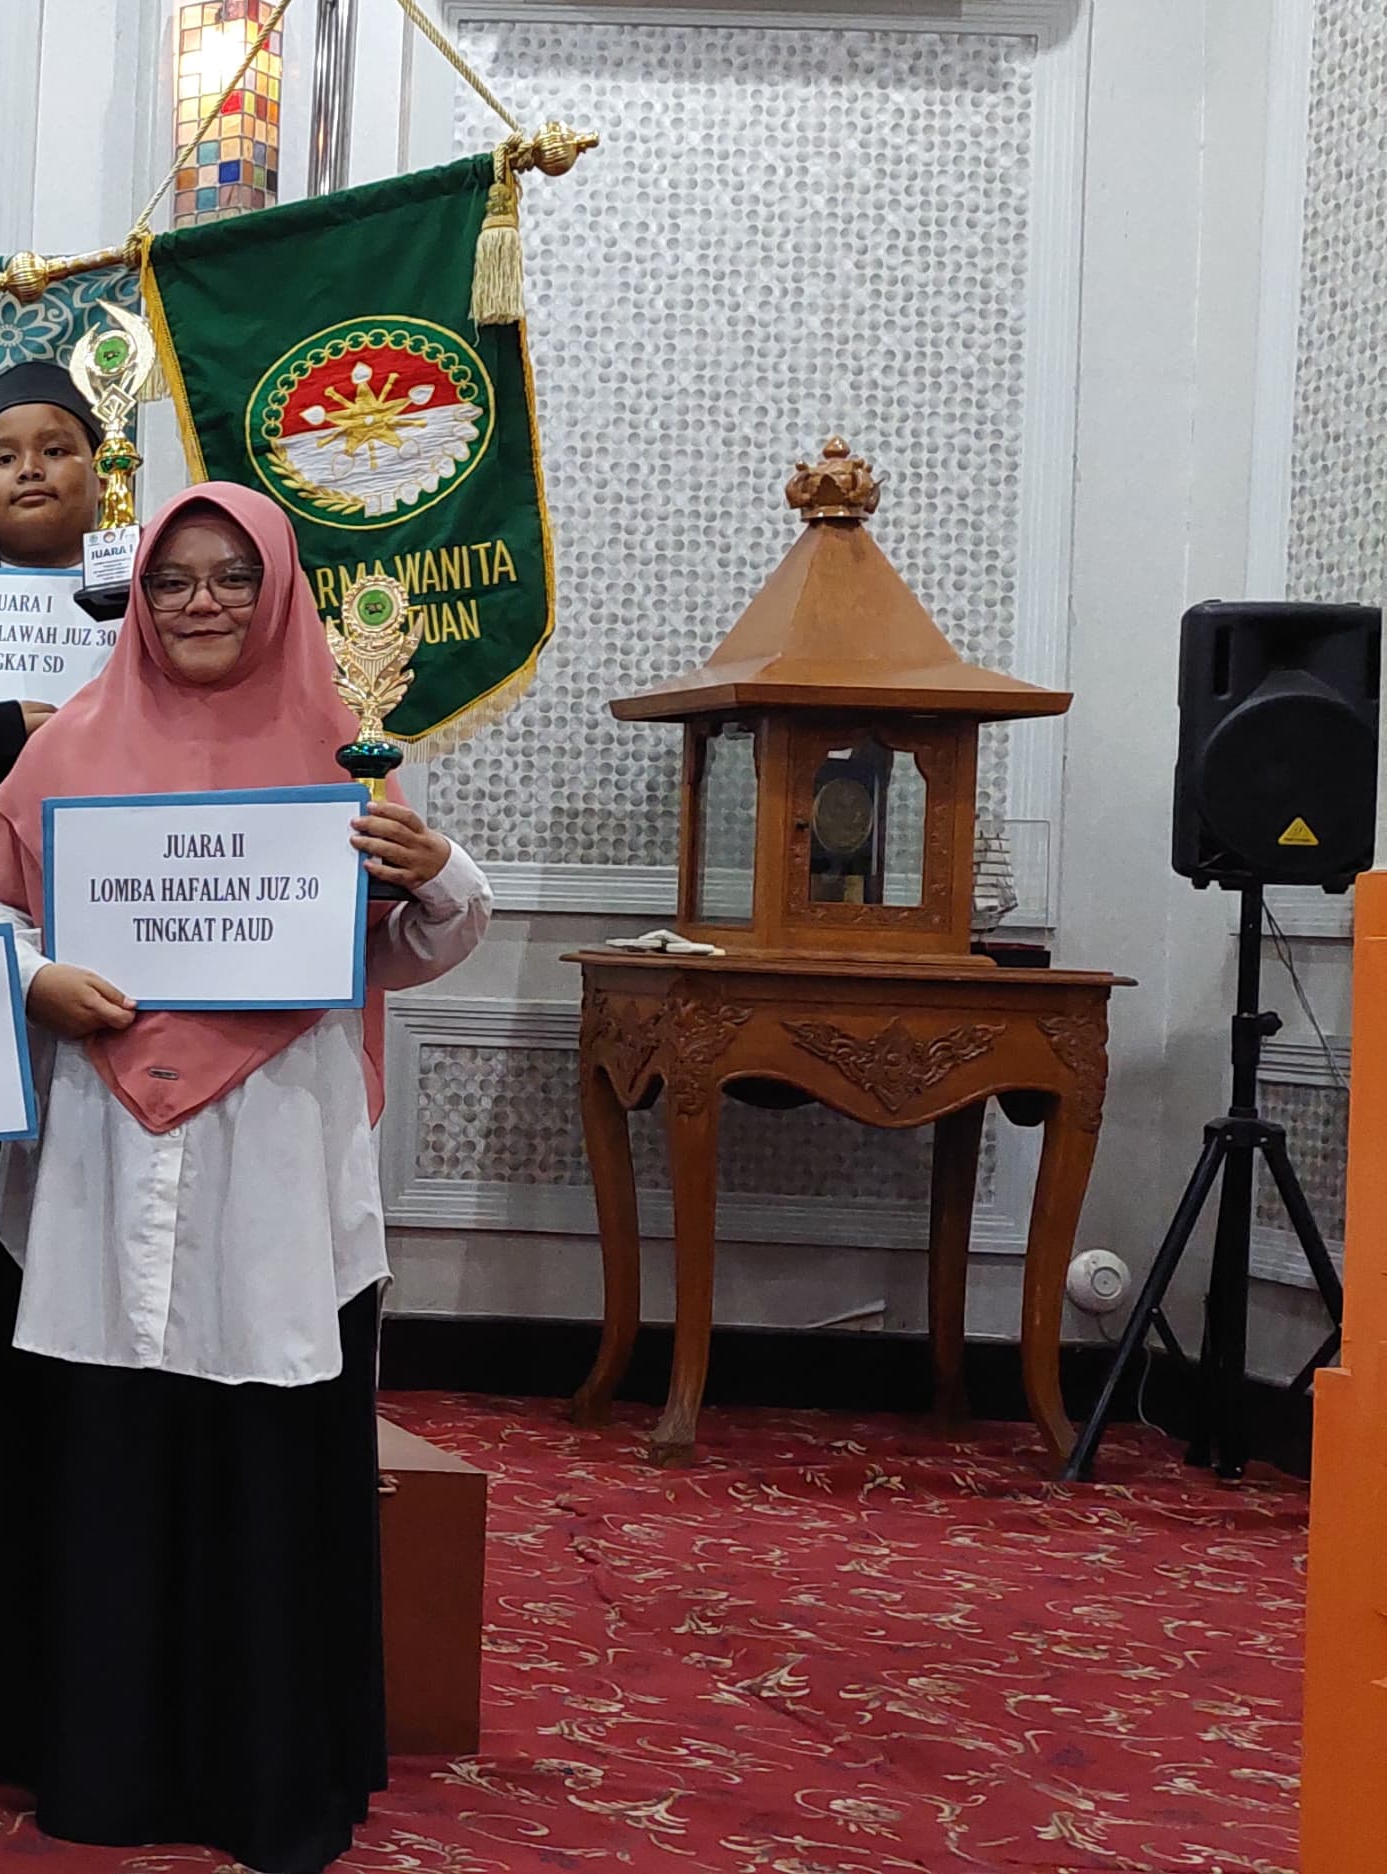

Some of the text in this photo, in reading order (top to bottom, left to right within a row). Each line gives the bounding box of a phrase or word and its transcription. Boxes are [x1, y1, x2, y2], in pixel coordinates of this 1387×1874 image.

[91, 546, 127, 560] JUARA
[394, 540, 517, 589] WANITA
[46, 595, 53, 614] I
[62, 627, 93, 647] JUZ
[96, 628, 117, 648] 30
[43, 654, 64, 674] SD
[163, 833, 245, 858] JUARA II
[90, 876, 319, 902] LOMBA HAFALAN JUZ 30
[133, 917, 274, 942] TINGKAT PAUD
